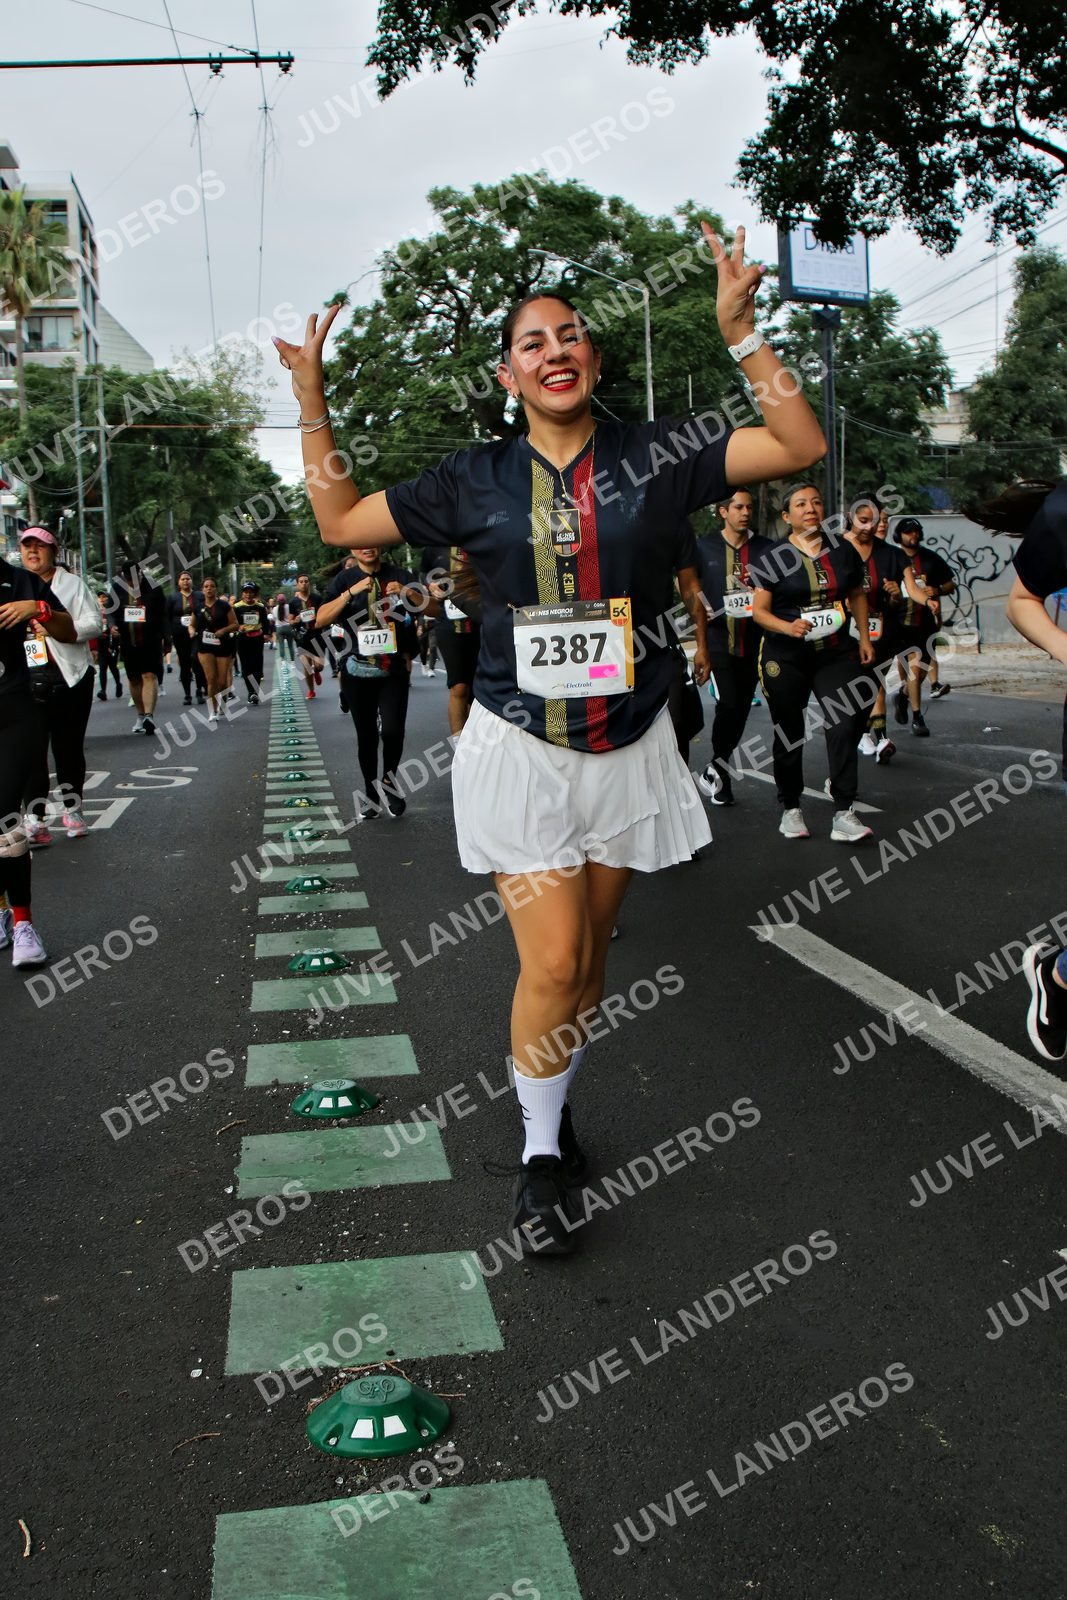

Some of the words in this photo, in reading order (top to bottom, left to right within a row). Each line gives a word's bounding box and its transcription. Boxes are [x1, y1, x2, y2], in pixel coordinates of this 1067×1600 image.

[728, 596, 750, 608] 4924
[612, 606, 627, 617] 5K
[364, 632, 388, 644] 4717
[530, 632, 608, 666] 2387
